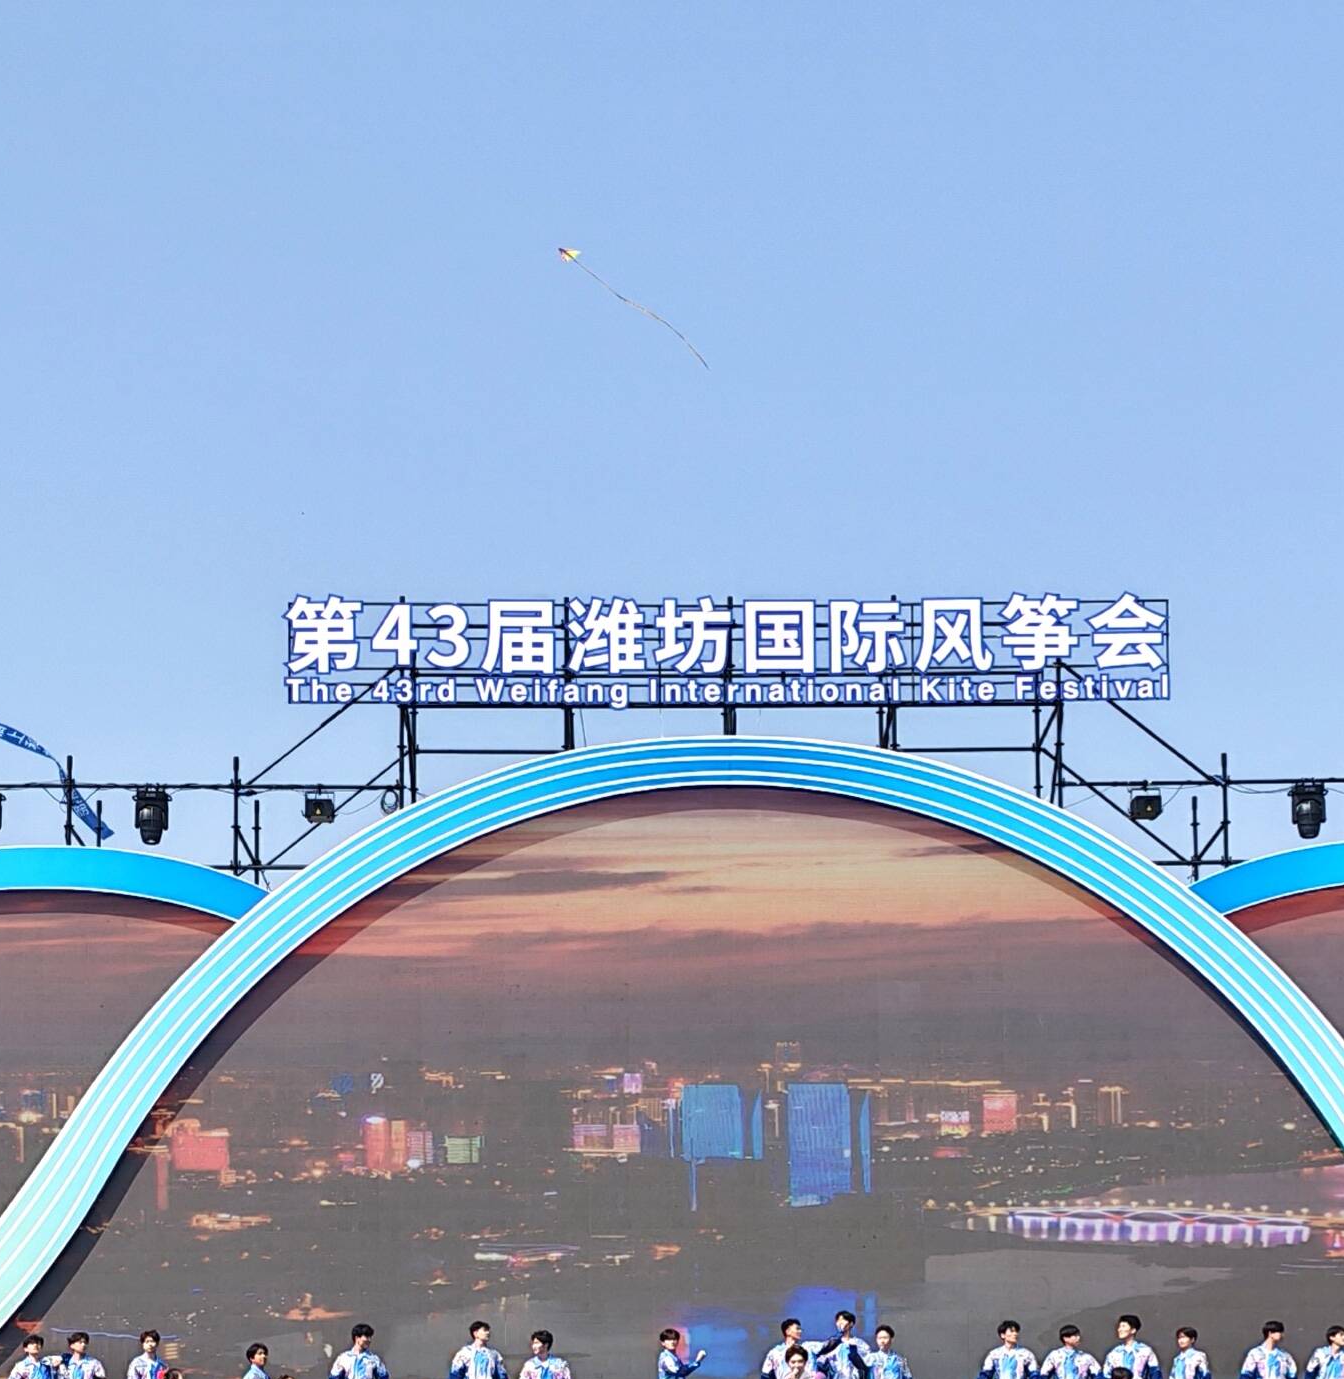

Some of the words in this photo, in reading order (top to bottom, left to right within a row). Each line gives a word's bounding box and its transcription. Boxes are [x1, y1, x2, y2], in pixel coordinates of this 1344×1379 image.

[285, 593, 1167, 674] 第43届潍坊国际风筝会
[285, 677, 354, 703] The
[373, 677, 456, 703] 43rd
[475, 677, 630, 709] Weifang
[648, 675, 902, 703] International
[920, 675, 998, 702] Kite
[1015, 673, 1171, 701] Festival
